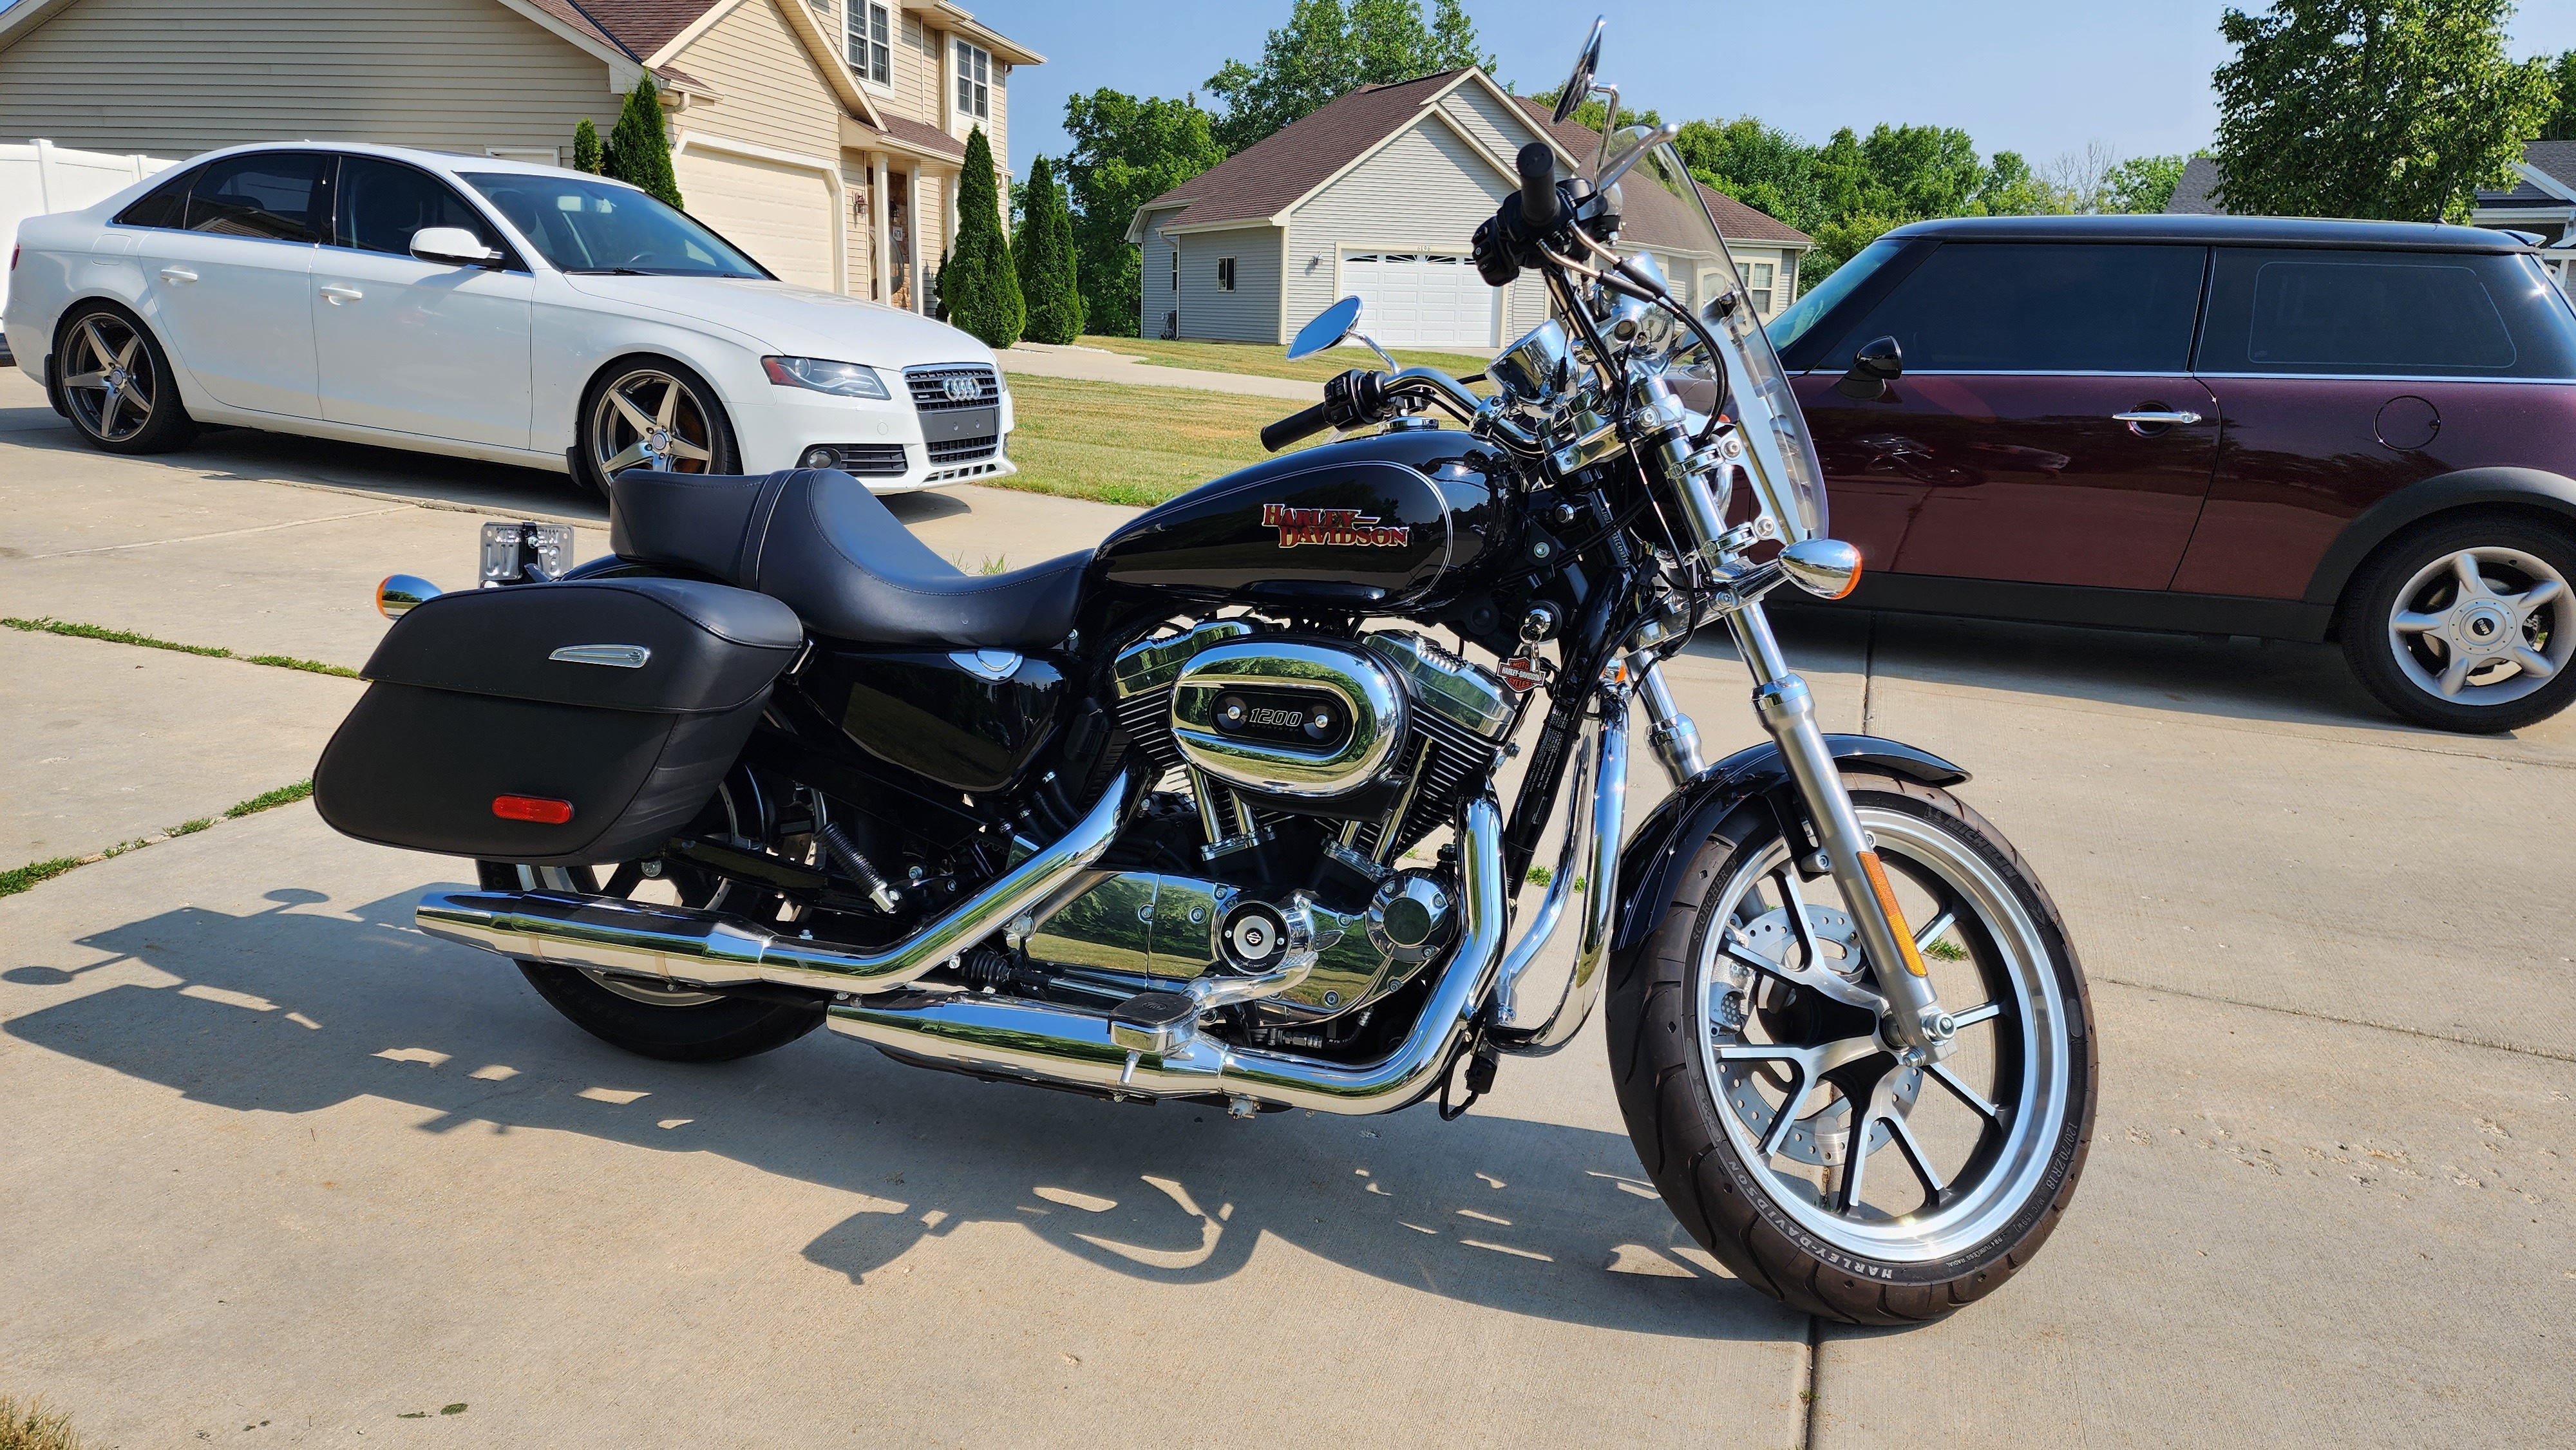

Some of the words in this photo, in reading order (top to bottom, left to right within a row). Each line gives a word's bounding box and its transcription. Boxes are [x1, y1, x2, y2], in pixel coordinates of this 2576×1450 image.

[1278, 526, 1410, 548] DAVIDSON
[1513, 661, 1530, 670] MOTO
[1510, 678, 1530, 688] CYCLES
[1249, 707, 1303, 727] 1200
[1692, 869, 1728, 942] SCORCHER
[2031, 1196, 2045, 1214] M/C
[1728, 1159, 1893, 1279] HARLEY-DAVIDSON
[1966, 1243, 1992, 1261] TUBELESS
[1945, 1257, 1966, 1268] RADIAL
